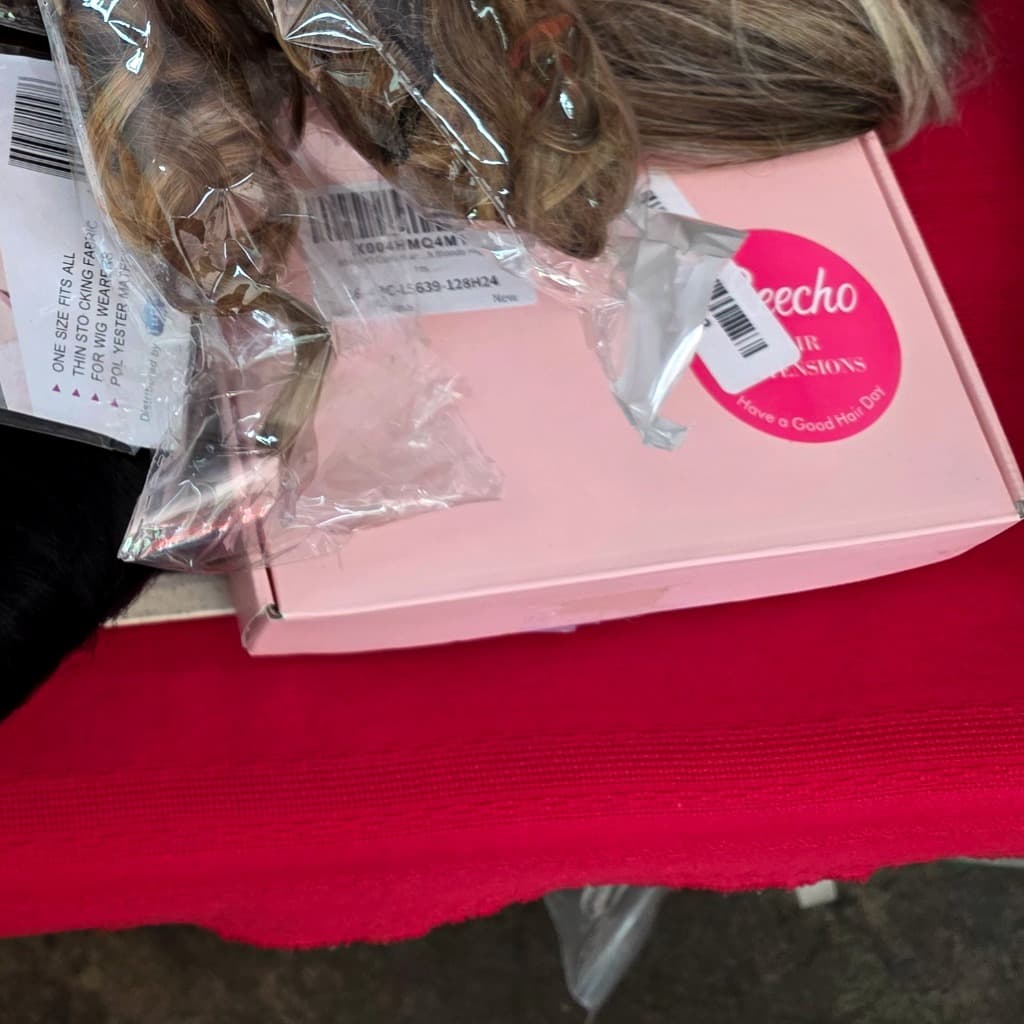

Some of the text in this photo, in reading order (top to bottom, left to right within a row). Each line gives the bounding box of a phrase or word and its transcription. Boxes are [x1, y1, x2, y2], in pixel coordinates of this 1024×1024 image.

[757, 267, 858, 317] eecho
[52, 252, 76, 373] ONE SIZE FITS ALL
[94, 322, 108, 349] WIG
[113, 302, 128, 355] YESTER
[72, 345, 86, 376] THIN
[150, 343, 162, 358] by
[91, 352, 105, 382] FOR
[111, 359, 124, 387] POL
[736, 385, 886, 432] Have a Good Hair Day
